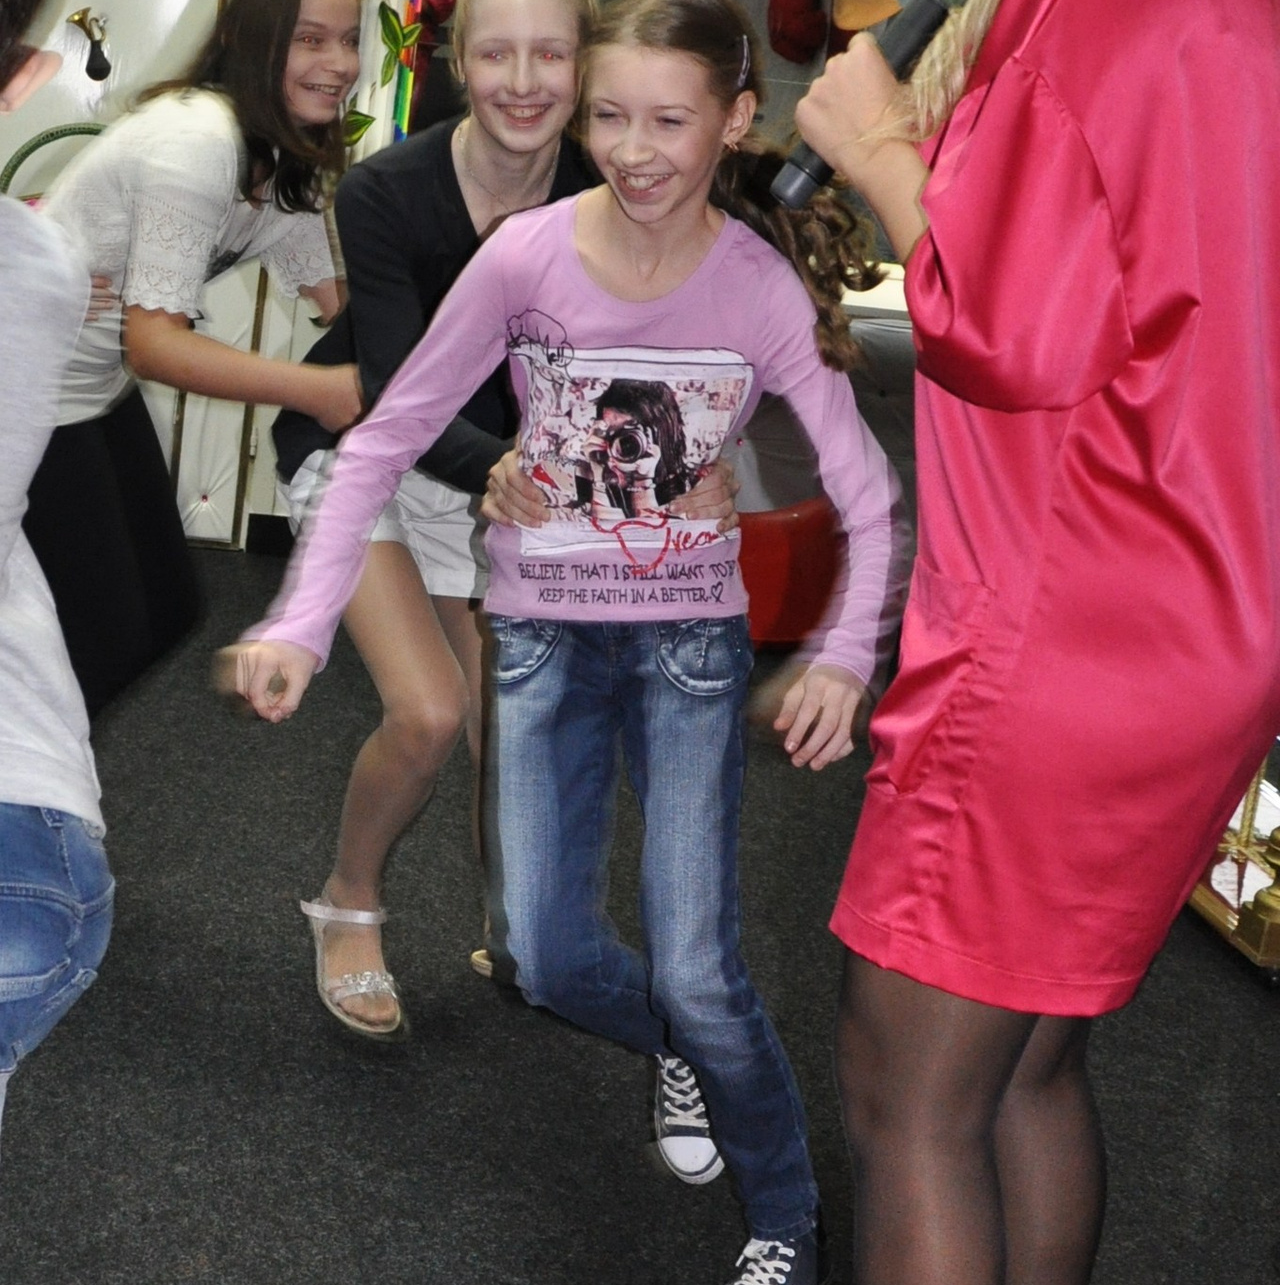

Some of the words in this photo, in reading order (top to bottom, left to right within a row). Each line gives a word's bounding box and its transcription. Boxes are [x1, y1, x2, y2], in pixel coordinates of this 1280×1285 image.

[518, 563, 566, 580] BELIEVE
[571, 563, 609, 580] THAT
[612, 564, 619, 580] I
[622, 564, 663, 581] STILL
[665, 562, 704, 580] WANT
[709, 562, 728, 578] TO
[538, 588, 565, 603] KEEP
[567, 588, 588, 603] THE
[591, 588, 627, 604] FAITH
[631, 588, 645, 603] IN
[648, 588, 659, 602] A
